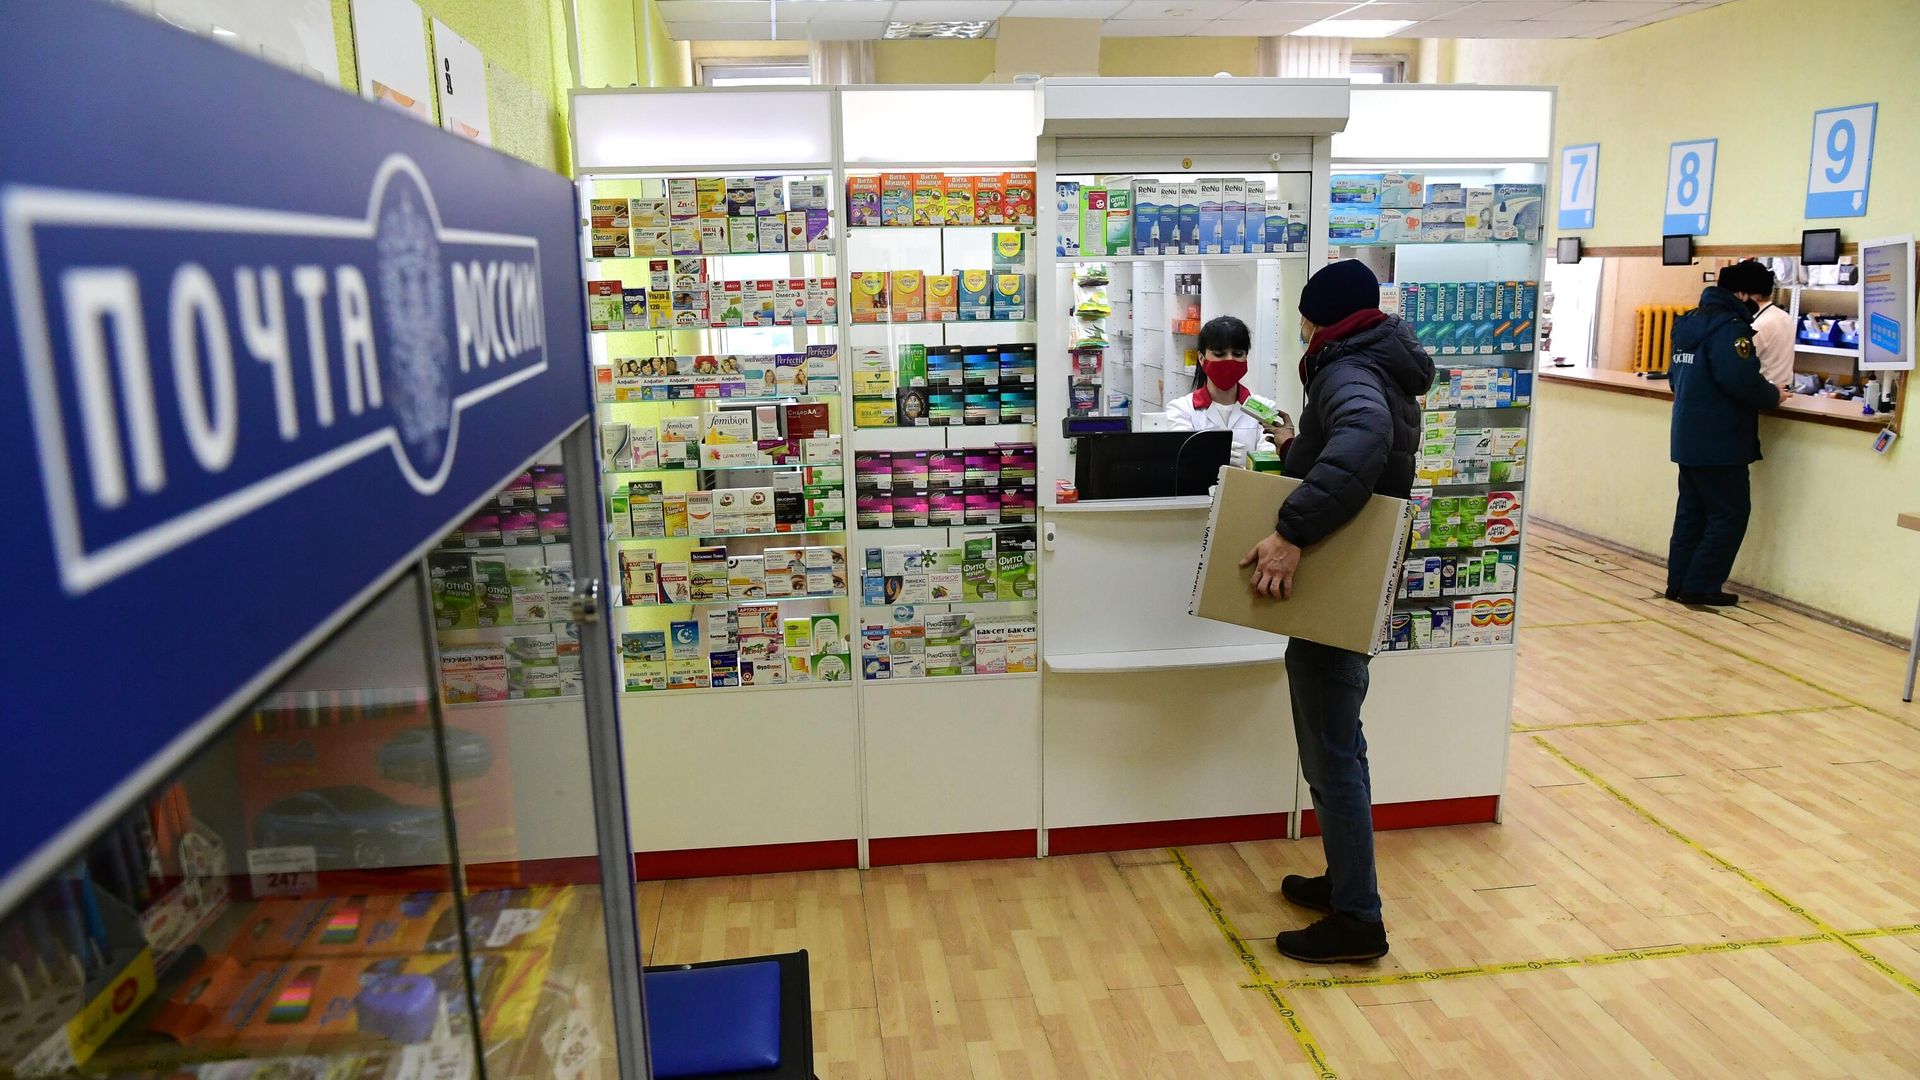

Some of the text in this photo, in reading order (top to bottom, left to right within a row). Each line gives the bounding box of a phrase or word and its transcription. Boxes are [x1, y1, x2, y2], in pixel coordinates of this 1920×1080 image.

[1825, 119, 1856, 184] 9
[1570, 154, 1588, 202] 7
[1677, 151, 1700, 206] 8
[1138, 186, 1157, 194] ReNu
[1202, 185, 1220, 193] ReNu
[1224, 184, 1243, 192] ReNu
[808, 347, 834, 356] Perfectil
[776, 354, 803, 365] Perfectil
[62, 260, 541, 509] ПОЧТА РОССИИ
[664, 422, 693, 432] femibion
[707, 414, 749, 429] femibion
